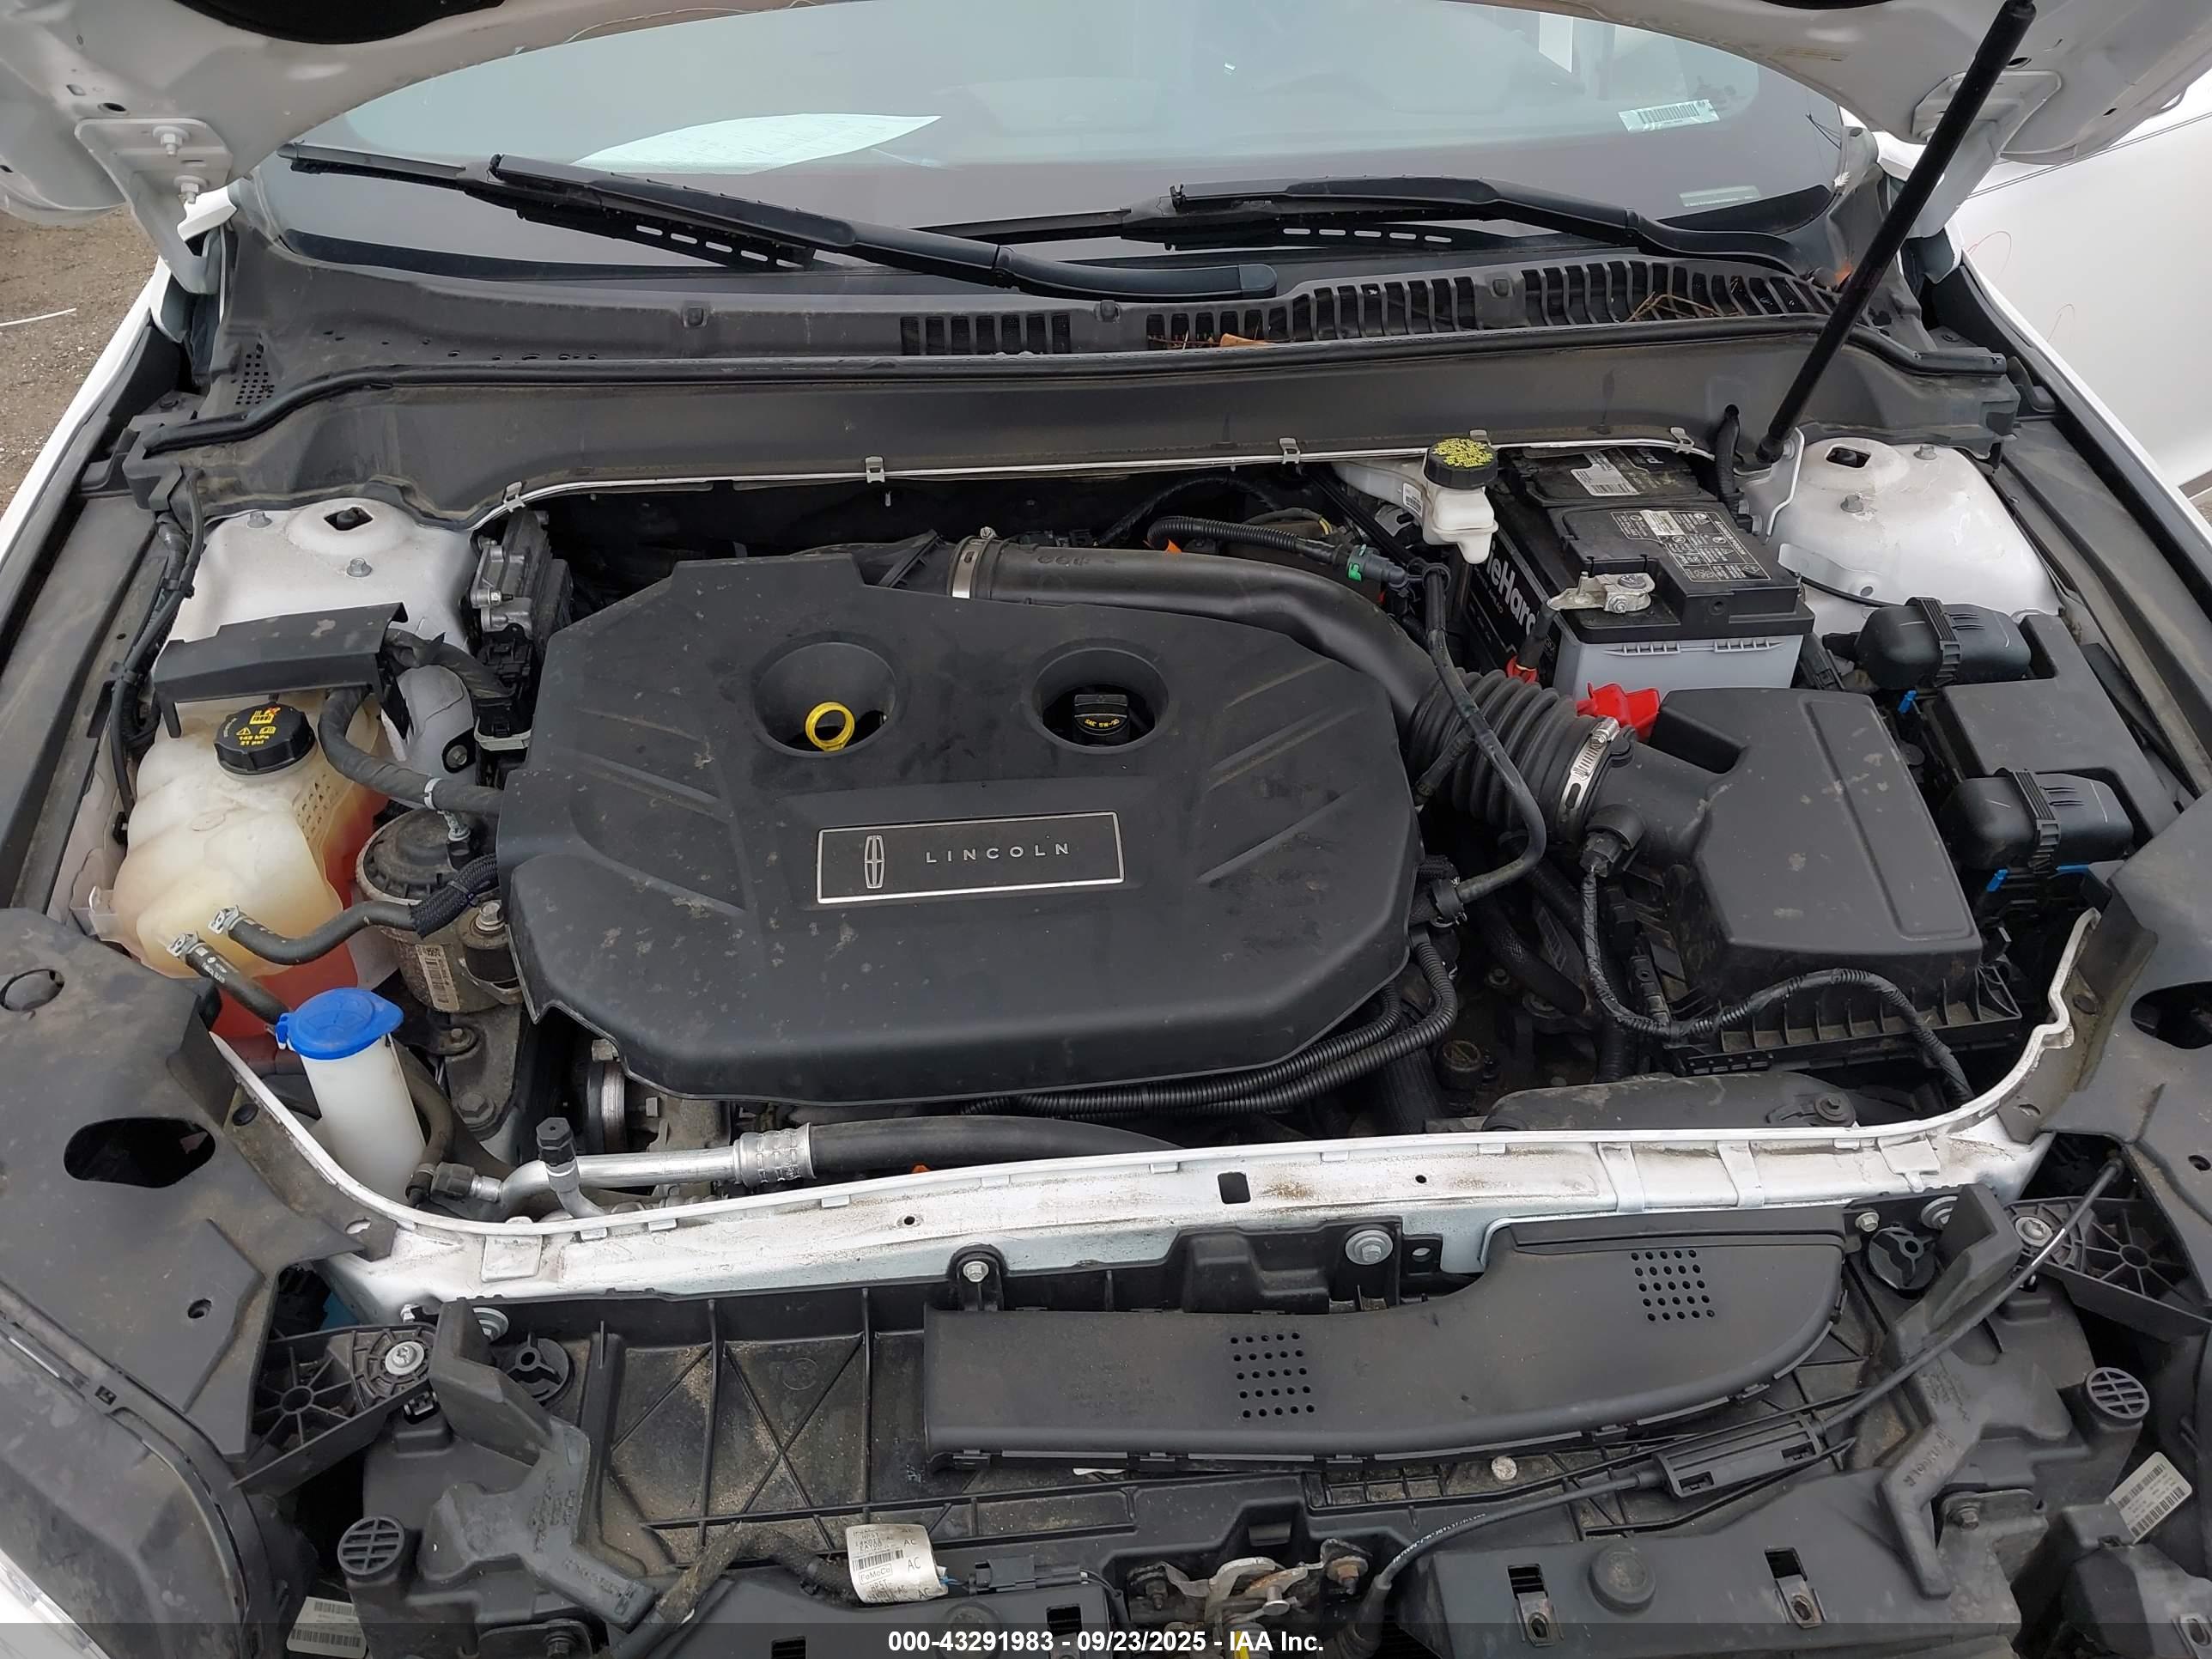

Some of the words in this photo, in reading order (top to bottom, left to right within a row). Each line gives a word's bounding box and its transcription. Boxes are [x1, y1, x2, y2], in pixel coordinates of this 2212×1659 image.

[1486, 540, 1538, 636] ieHar
[926, 842, 1070, 863] LINCOLN
[903, 1538, 917, 1547] AC
[907, 1556, 921, 1572] AC
[860, 1567, 891, 1583] FoMoCo
[918, 1587, 929, 1599] AC
